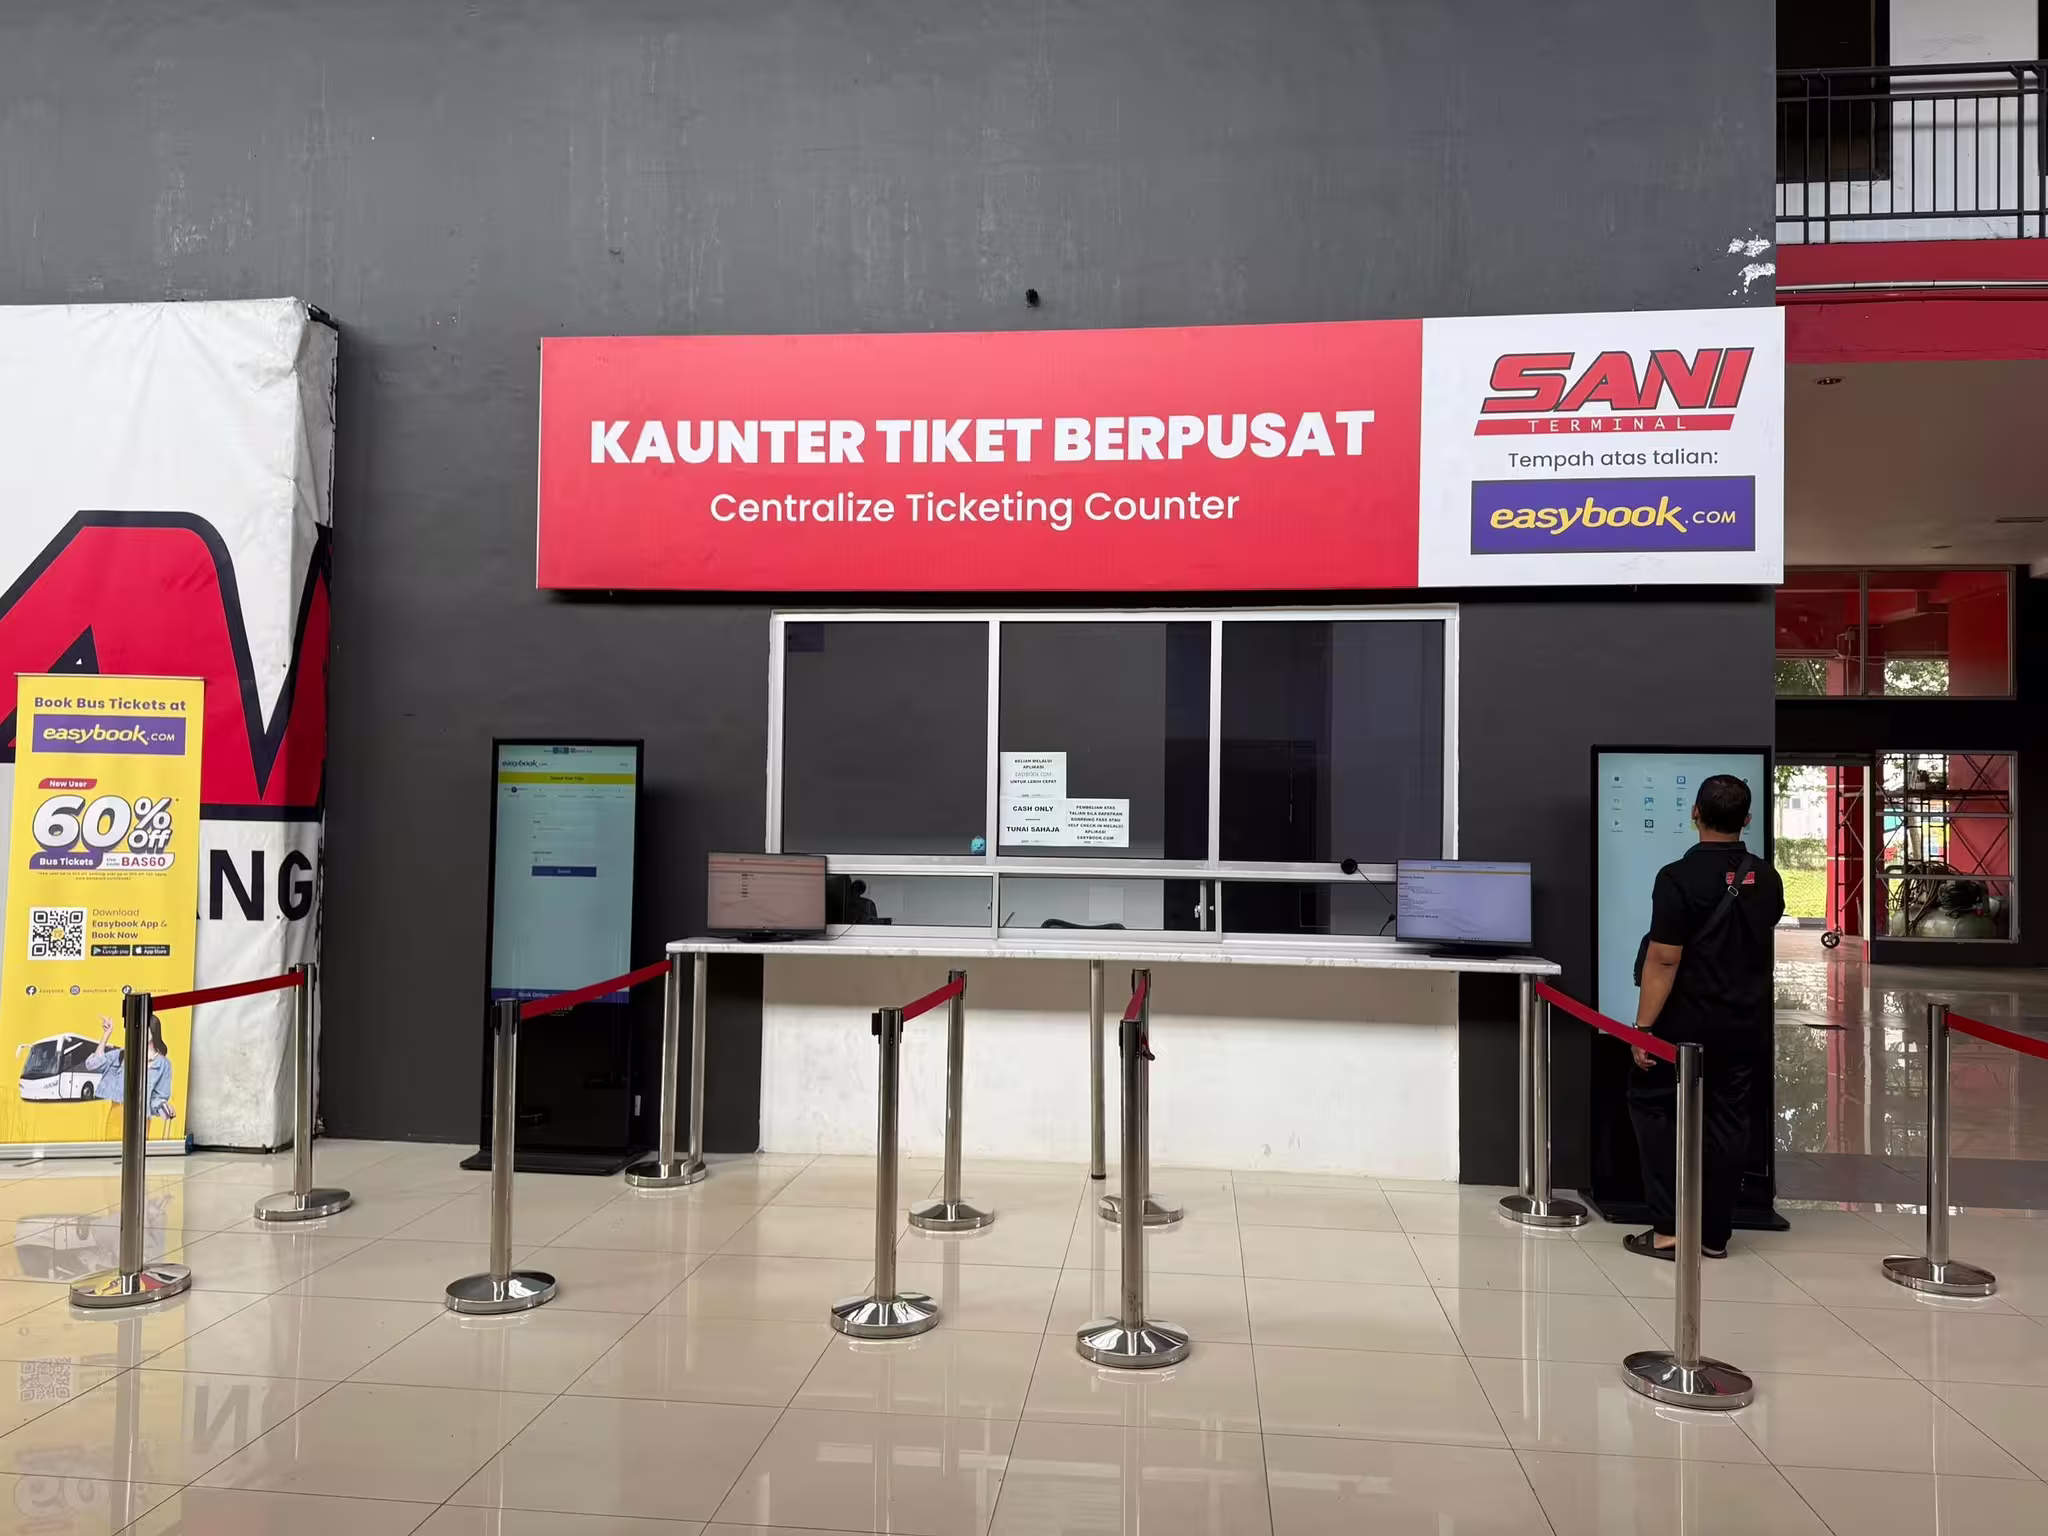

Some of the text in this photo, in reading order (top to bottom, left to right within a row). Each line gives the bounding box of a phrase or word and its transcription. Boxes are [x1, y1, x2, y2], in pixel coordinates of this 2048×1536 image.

[1480, 347, 1755, 414] SANI
[1528, 416, 1687, 433] TERMINAL
[590, 410, 1375, 464] KAUNTER TIKET BERPUSAT
[1508, 448, 1719, 472] Tempah atas talian:
[710, 490, 1240, 531] Centralize Ticketing Counter
[34, 697, 186, 711] Book Bus Tickets at
[49, 779, 88, 788] New User
[39, 857, 94, 867] Bus Tickets
[121, 856, 166, 868] BAS60
[197, 848, 314, 922] NG
[92, 908, 140, 917] Download
[92, 919, 138, 930] Easybook
[140, 920, 160, 931] App
[92, 931, 139, 939] Book Now
